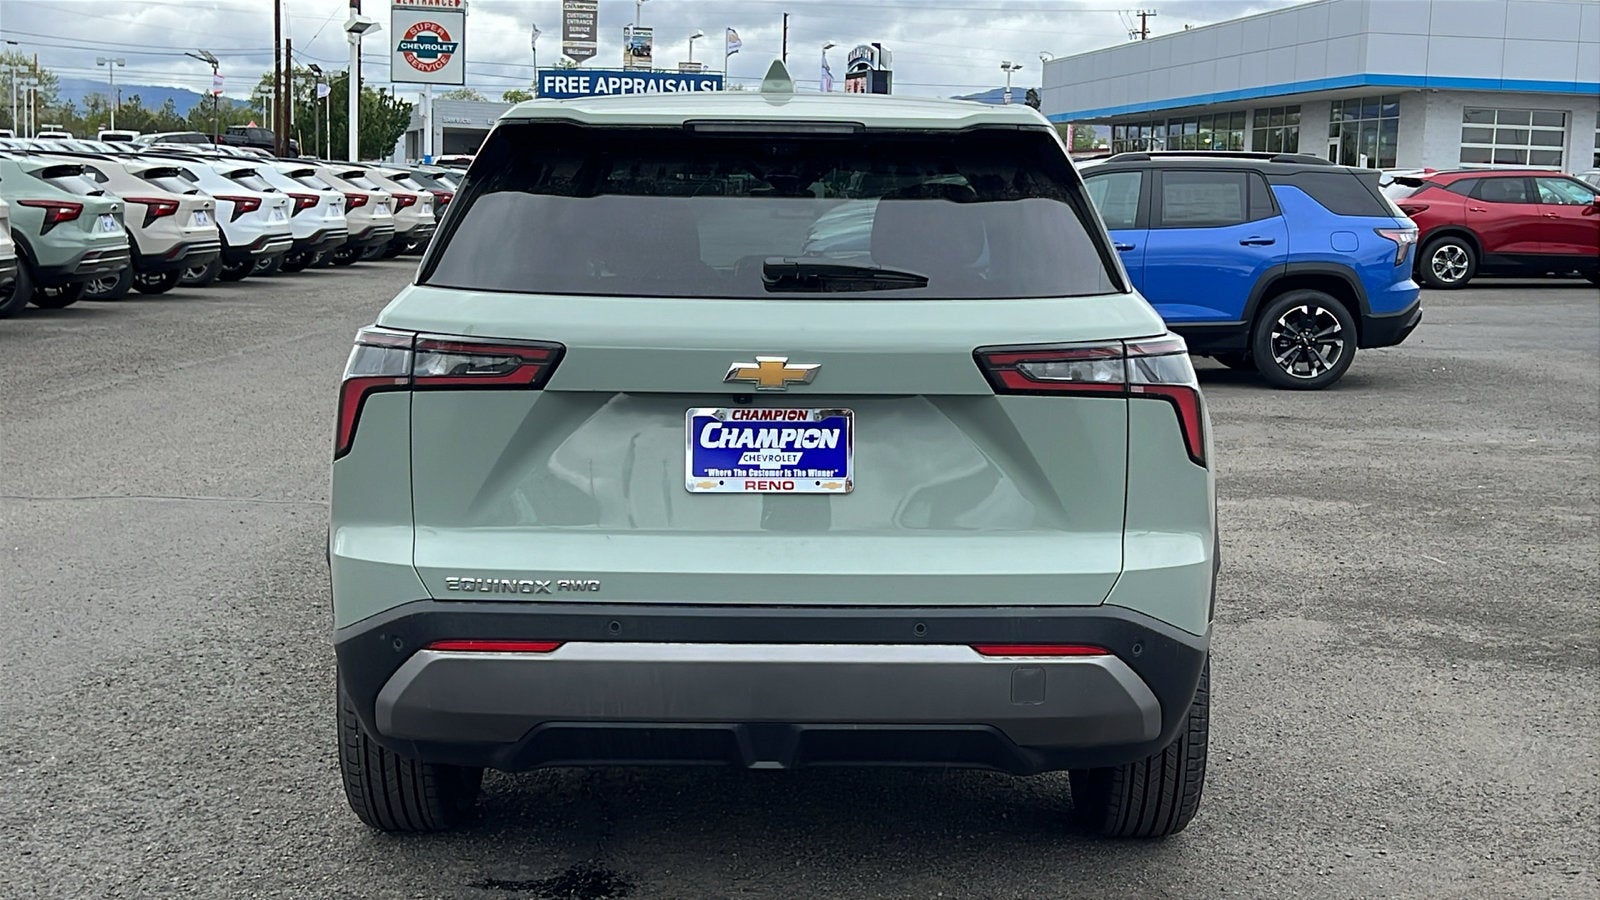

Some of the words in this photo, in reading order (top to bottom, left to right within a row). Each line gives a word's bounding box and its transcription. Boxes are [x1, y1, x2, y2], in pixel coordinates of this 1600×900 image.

[409, 23, 445, 36] SUPER
[400, 42, 454, 51] CHEVROLET
[407, 54, 447, 71] SERVICE
[544, 76, 590, 94] FREE
[732, 409, 808, 421] CHAMPION
[699, 422, 841, 449] CHAMPION
[743, 454, 798, 463] CHEVROLET
[733, 468, 747, 478] The
[748, 468, 783, 478] Customer
[784, 468, 792, 478] Is
[793, 468, 807, 478] The
[744, 480, 795, 491] RENO
[446, 576, 552, 594] EQUINOX
[557, 579, 600, 592] AWD
